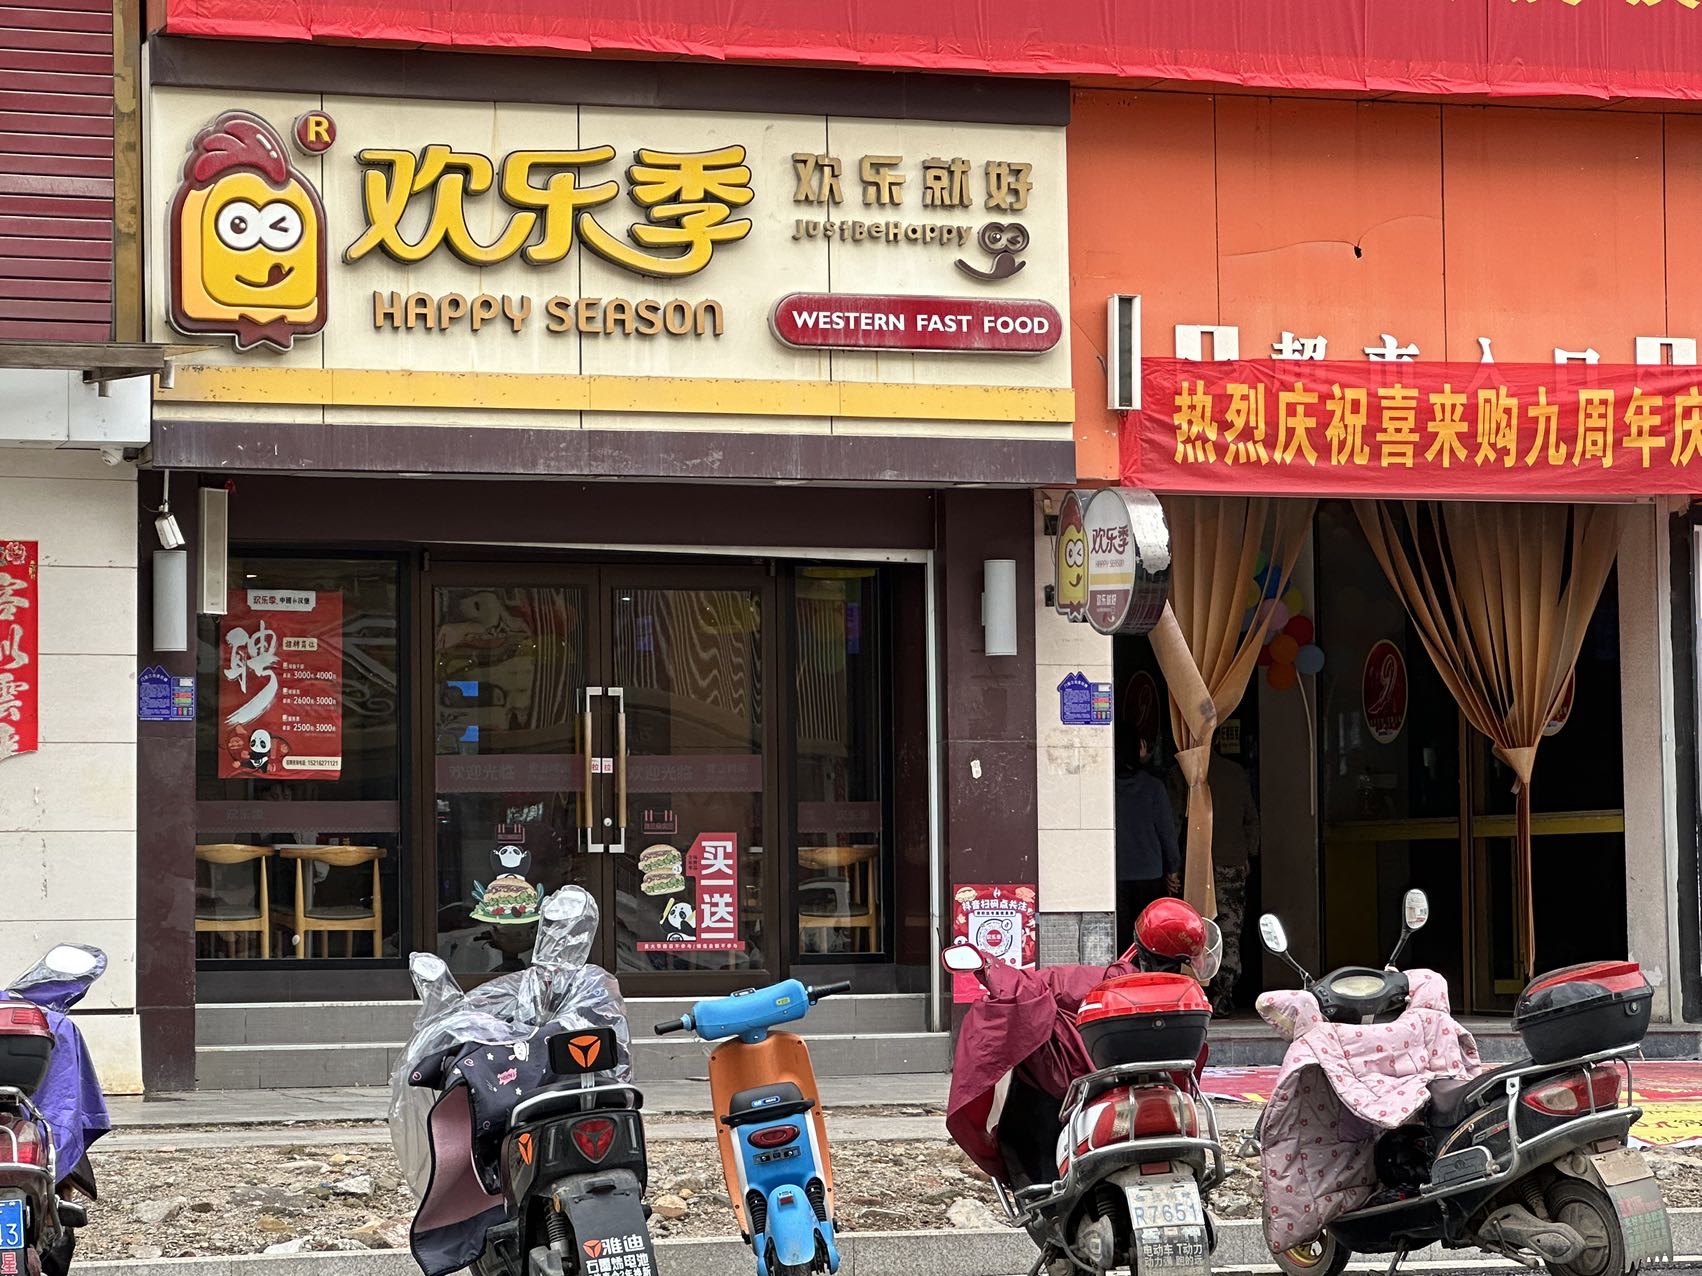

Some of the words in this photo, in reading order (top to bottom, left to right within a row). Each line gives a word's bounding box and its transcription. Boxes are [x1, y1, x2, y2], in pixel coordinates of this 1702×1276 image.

[792, 152, 1033, 210] 欢乐就好
[342, 143, 755, 279] 欢乐季
[373, 290, 531, 333] HAPPY
[545, 295, 724, 336] SEASON
[792, 310, 905, 331] WESTERN
[917, 314, 972, 332] FAST
[984, 316, 1049, 334] FOOD
[1174, 380, 1702, 468] 热烈庆祝喜来购九周年庆
[1090, 525, 1129, 555] 欢乐季
[700, 841, 734, 938] 买一送一
[962, 899, 1028, 912] 抖音扫码点关注
[1134, 1203, 1198, 1226] R7651
[601, 1234, 645, 1255] 雅迪
[1143, 1243, 1173, 1256] 电动车
[586, 1253, 649, 1274] 石墨烯电池
